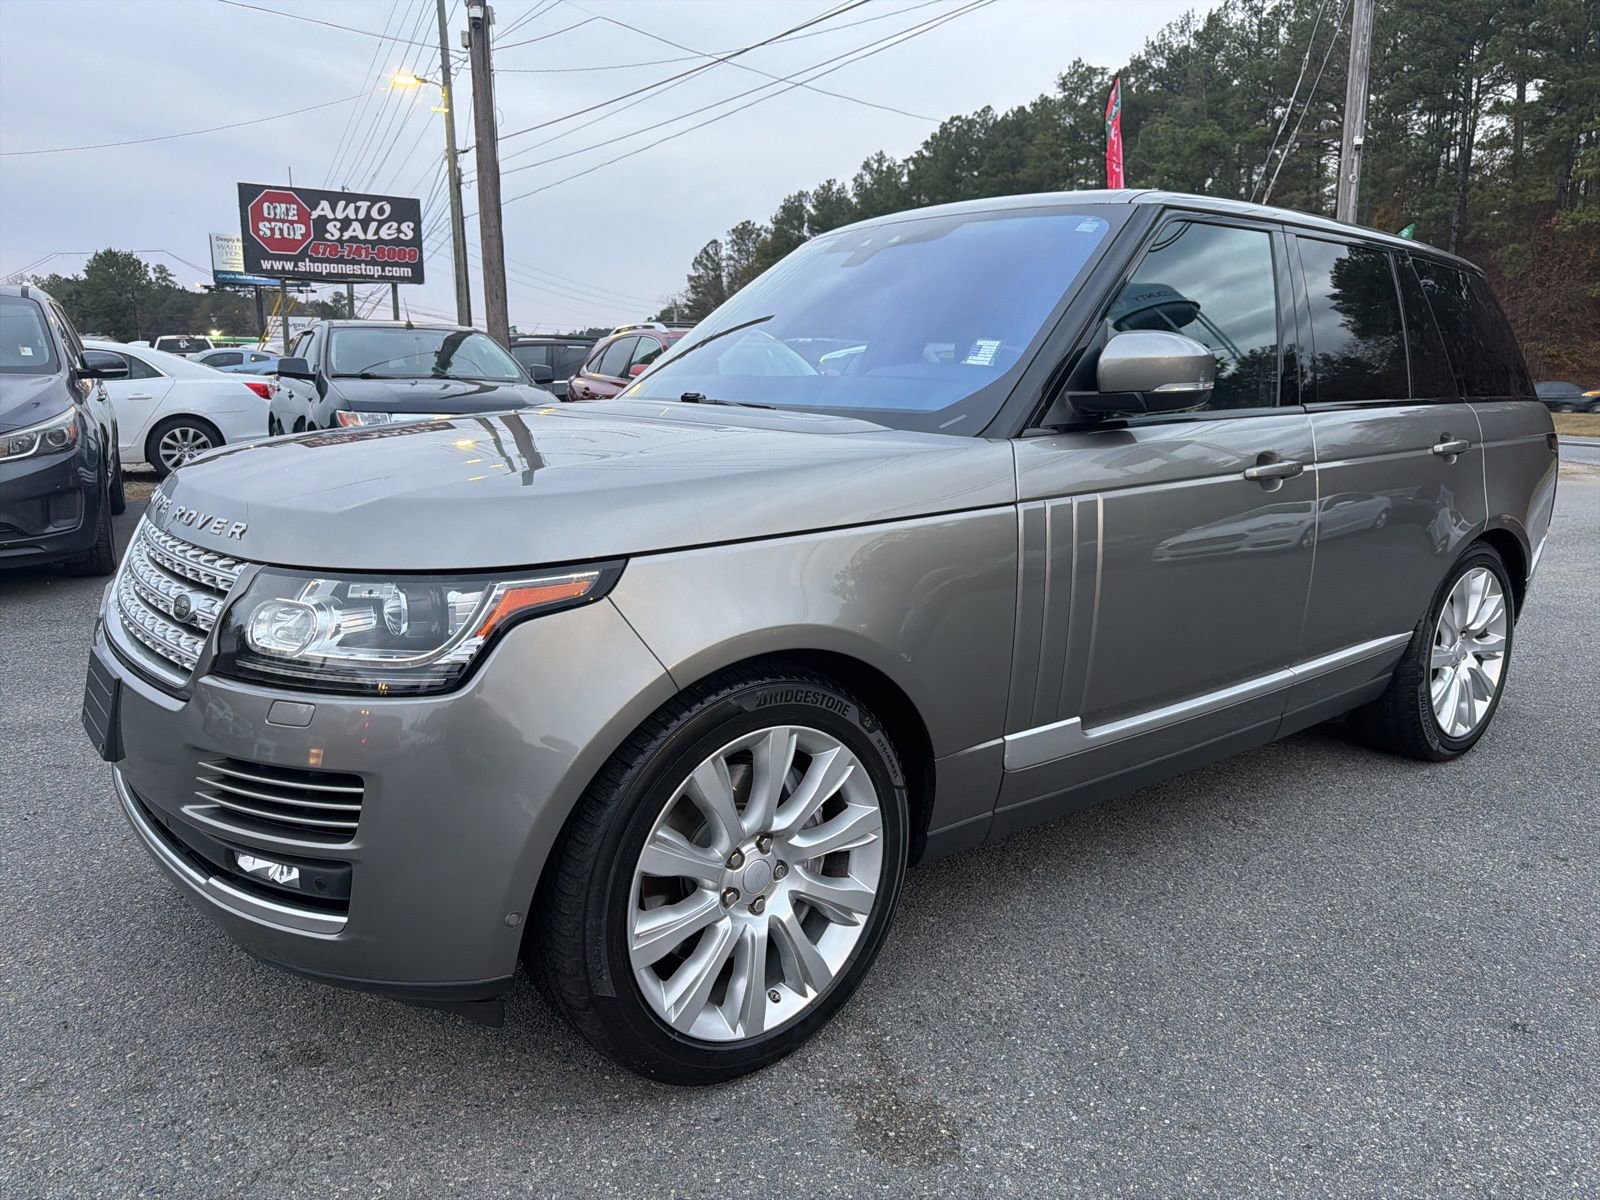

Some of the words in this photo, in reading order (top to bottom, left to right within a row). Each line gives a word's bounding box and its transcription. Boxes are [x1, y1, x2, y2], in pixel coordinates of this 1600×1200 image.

[262, 201, 298, 221] ONE
[310, 199, 391, 220] AUTO
[258, 220, 306, 240] STOP
[324, 220, 415, 241] SALES
[260, 257, 412, 277] www.shoponestop.com
[172, 505, 249, 541] ROVER
[755, 688, 852, 718] BRIDGESTONE
